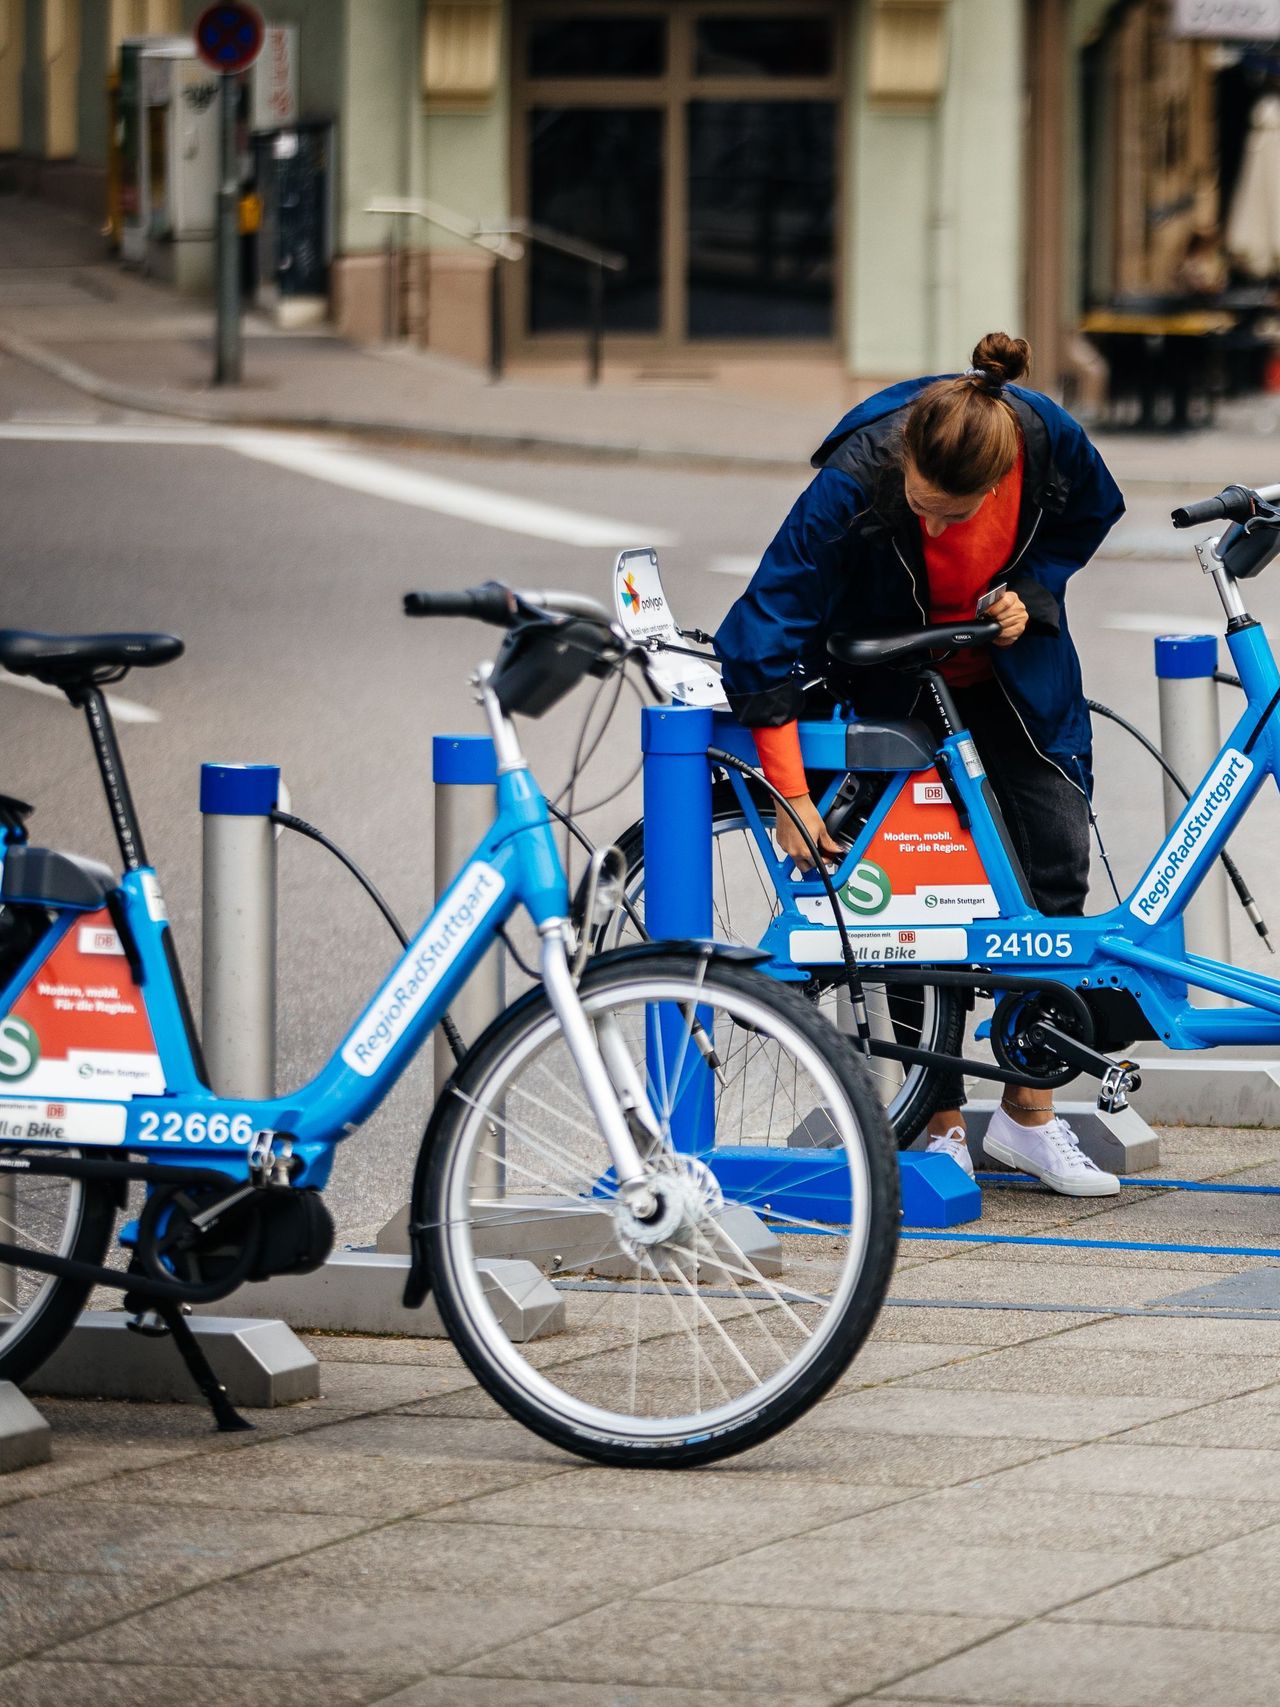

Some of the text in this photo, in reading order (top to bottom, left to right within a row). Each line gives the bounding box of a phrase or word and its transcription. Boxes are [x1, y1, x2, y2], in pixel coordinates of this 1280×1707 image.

[641, 596, 663, 612] polygo
[926, 788, 941, 798] DB
[884, 831, 952, 842] Modern, mobil.
[1138, 756, 1244, 916] RegioRadStuttgart
[900, 842, 967, 853] Für die Region.
[847, 862, 884, 910] S
[939, 897, 956, 905] Bahn
[957, 897, 985, 905] Stuttgart
[900, 932, 914, 942] DB
[871, 949, 880, 960] a
[884, 946, 916, 959] Bike
[985, 933, 1073, 958] 24105
[354, 874, 492, 1063] RegioRadStuttgart
[38, 983, 85, 998] Modern,
[95, 1001, 137, 1015] Region.
[12, 1125, 23, 1138] a
[27, 1122, 65, 1139] Bike
[139, 1111, 253, 1145] 22666
